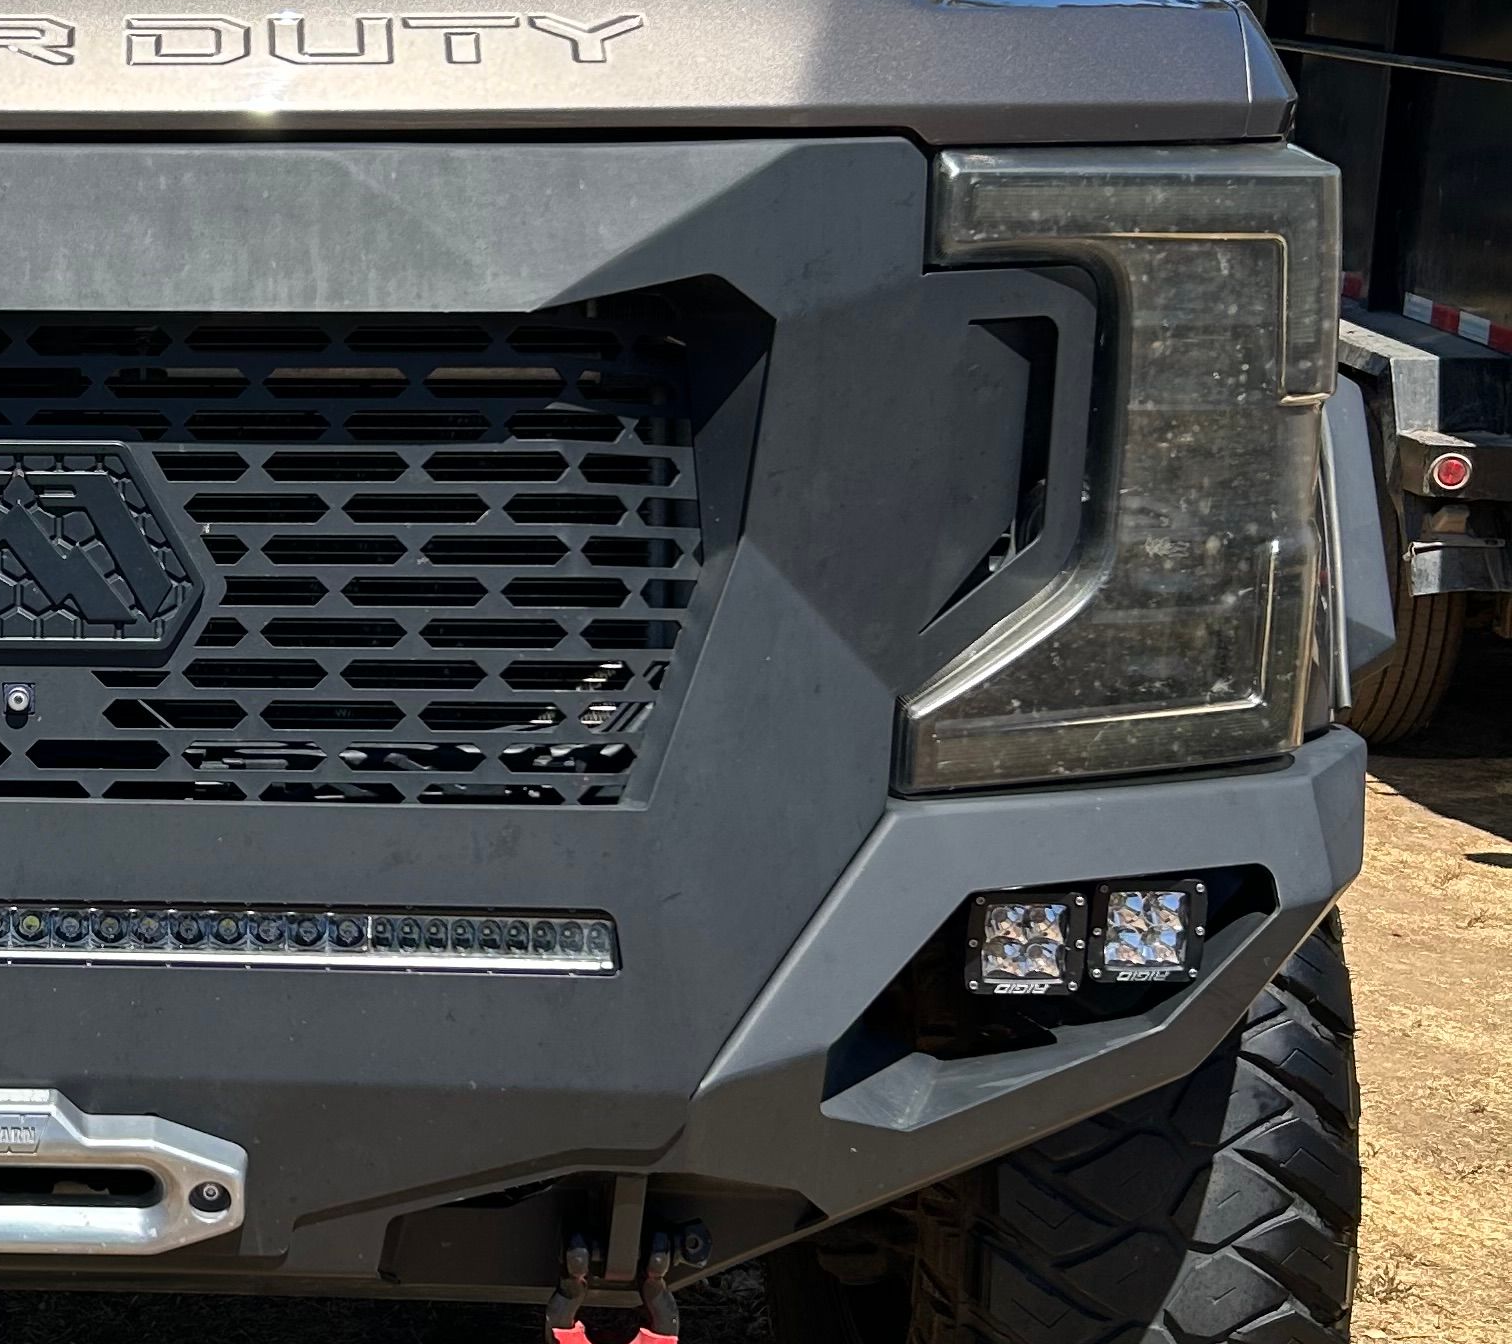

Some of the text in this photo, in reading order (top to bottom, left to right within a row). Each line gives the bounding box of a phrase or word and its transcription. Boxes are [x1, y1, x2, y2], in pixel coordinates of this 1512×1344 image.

[125, 13, 645, 66] DUTY
[1116, 970, 1172, 982] RIGID
[993, 983, 1051, 995] RIGID
